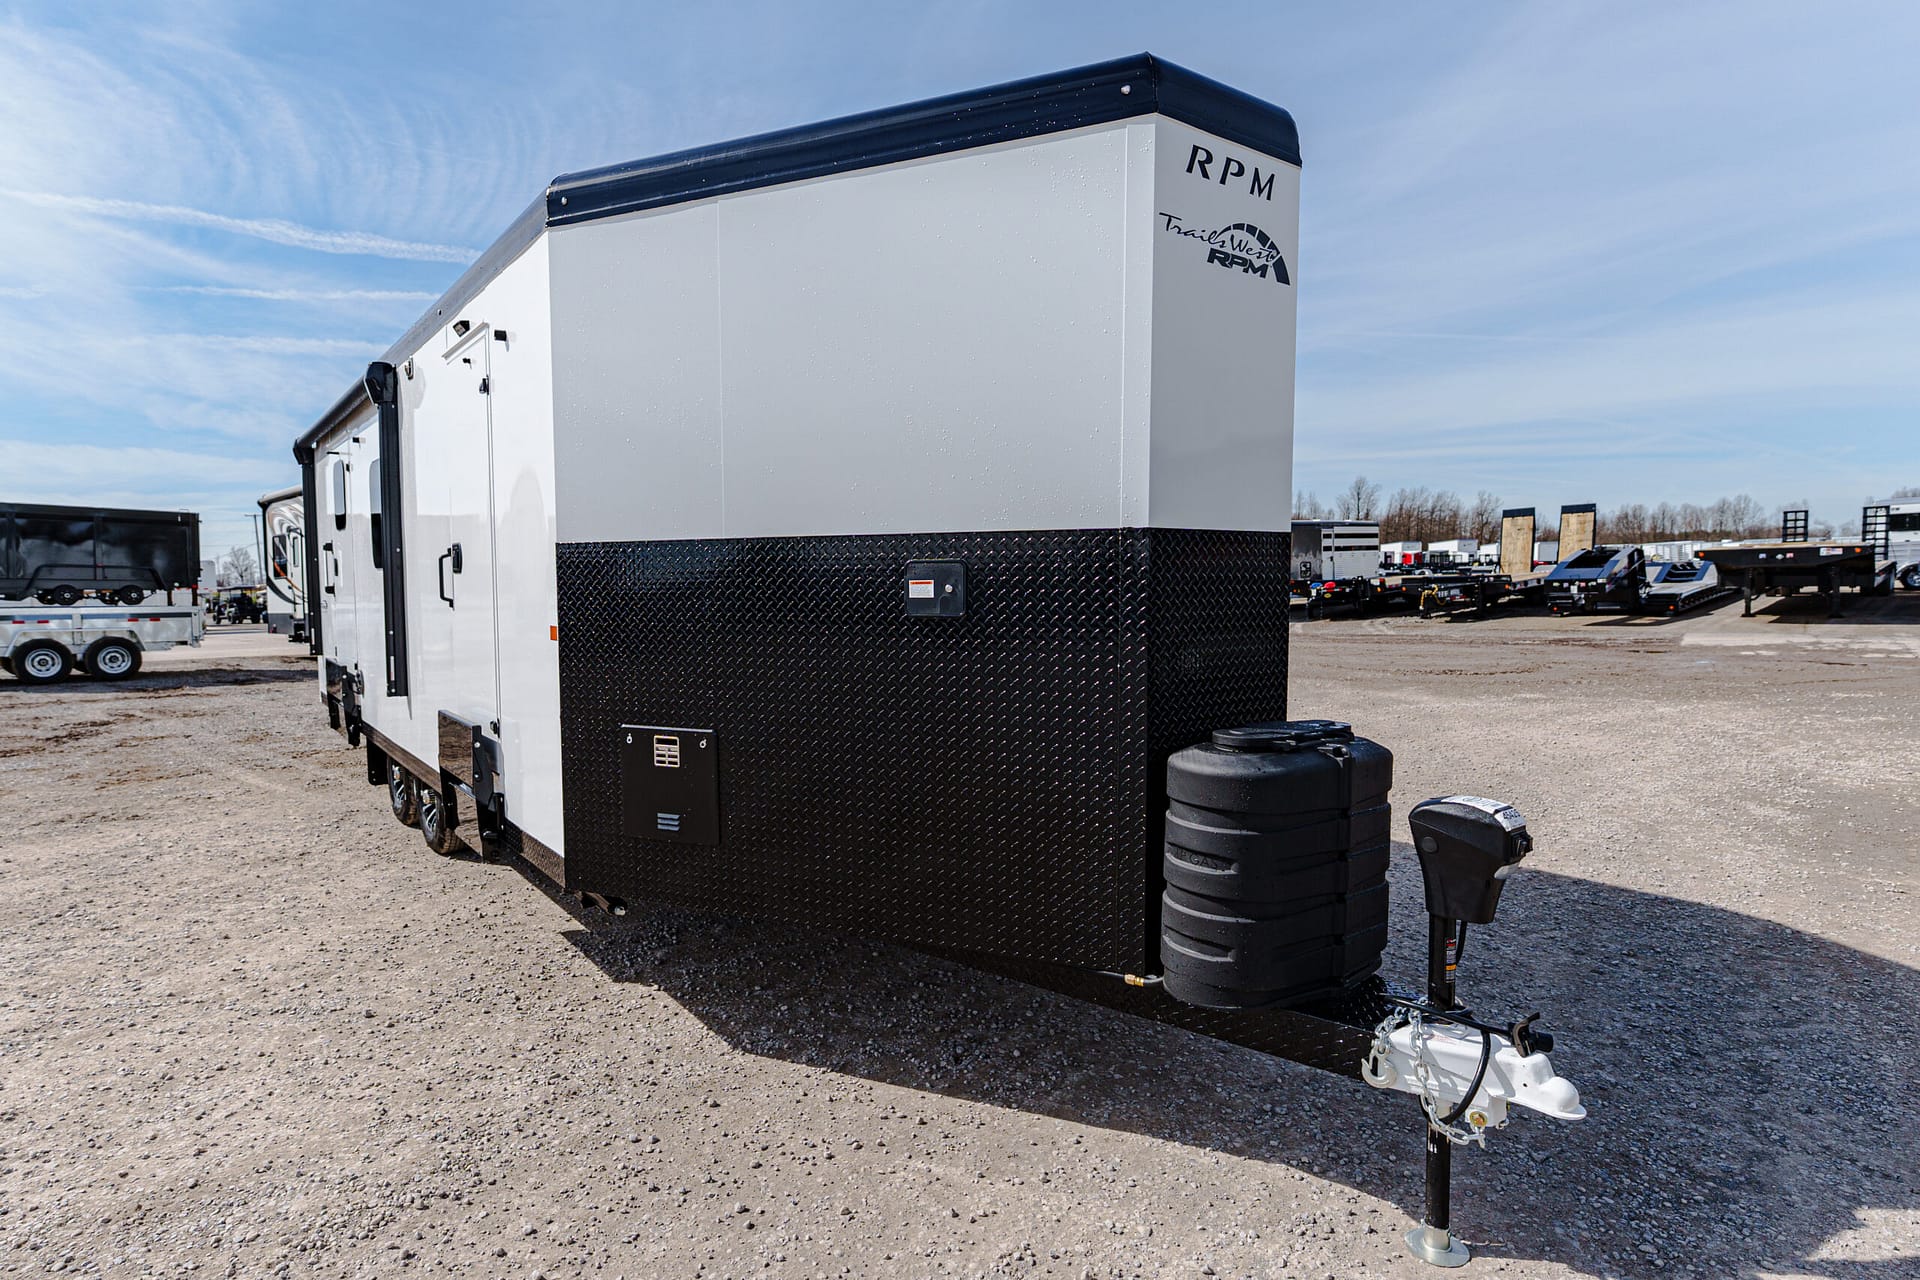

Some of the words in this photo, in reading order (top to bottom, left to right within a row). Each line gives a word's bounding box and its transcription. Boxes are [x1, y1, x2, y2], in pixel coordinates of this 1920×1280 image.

[1186, 144, 1275, 201] RPM
[1159, 212, 1227, 249] Trails
[1230, 234, 1275, 263] West
[1207, 248, 1269, 279] RPM
